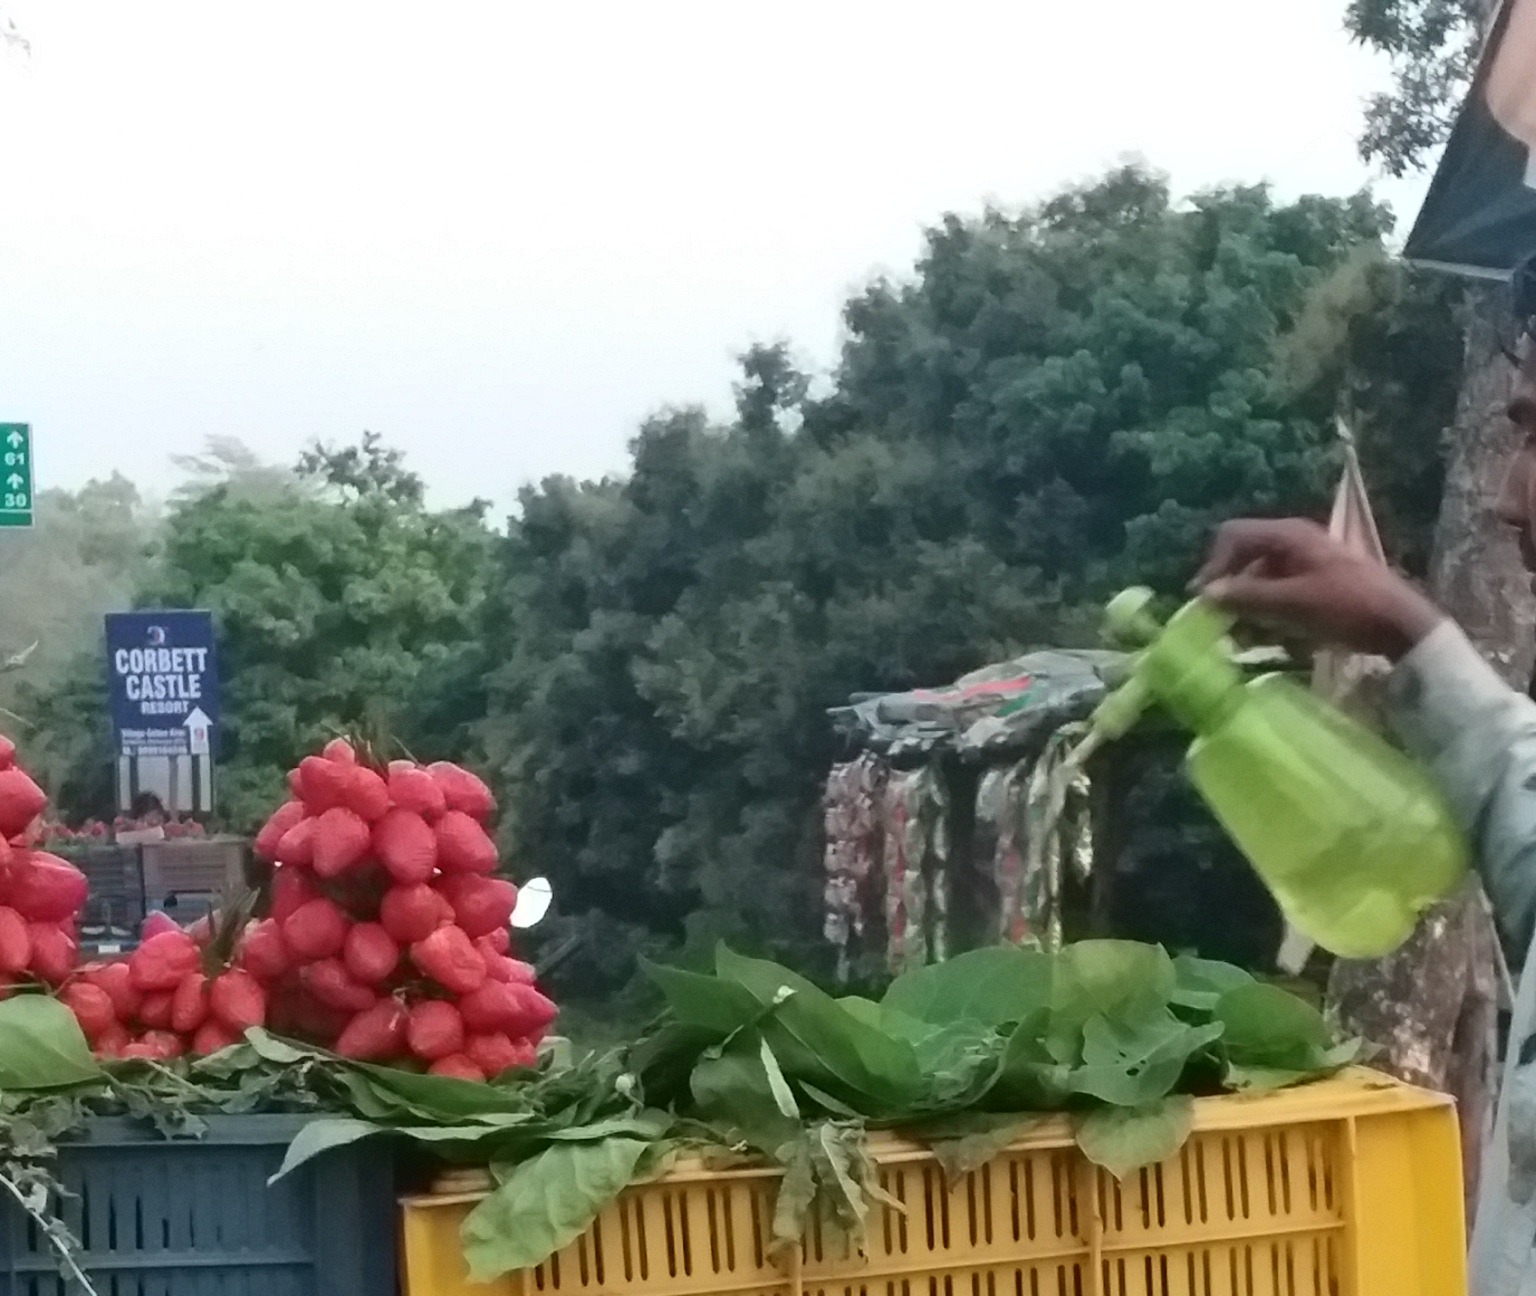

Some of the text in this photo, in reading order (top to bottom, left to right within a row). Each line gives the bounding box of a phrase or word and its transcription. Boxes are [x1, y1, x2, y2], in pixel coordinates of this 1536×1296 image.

[4, 452, 25, 466] 61
[115, 647, 208, 674] CORBETT
[126, 674, 202, 700] CASTLE
[141, 701, 189, 715] RESORT
